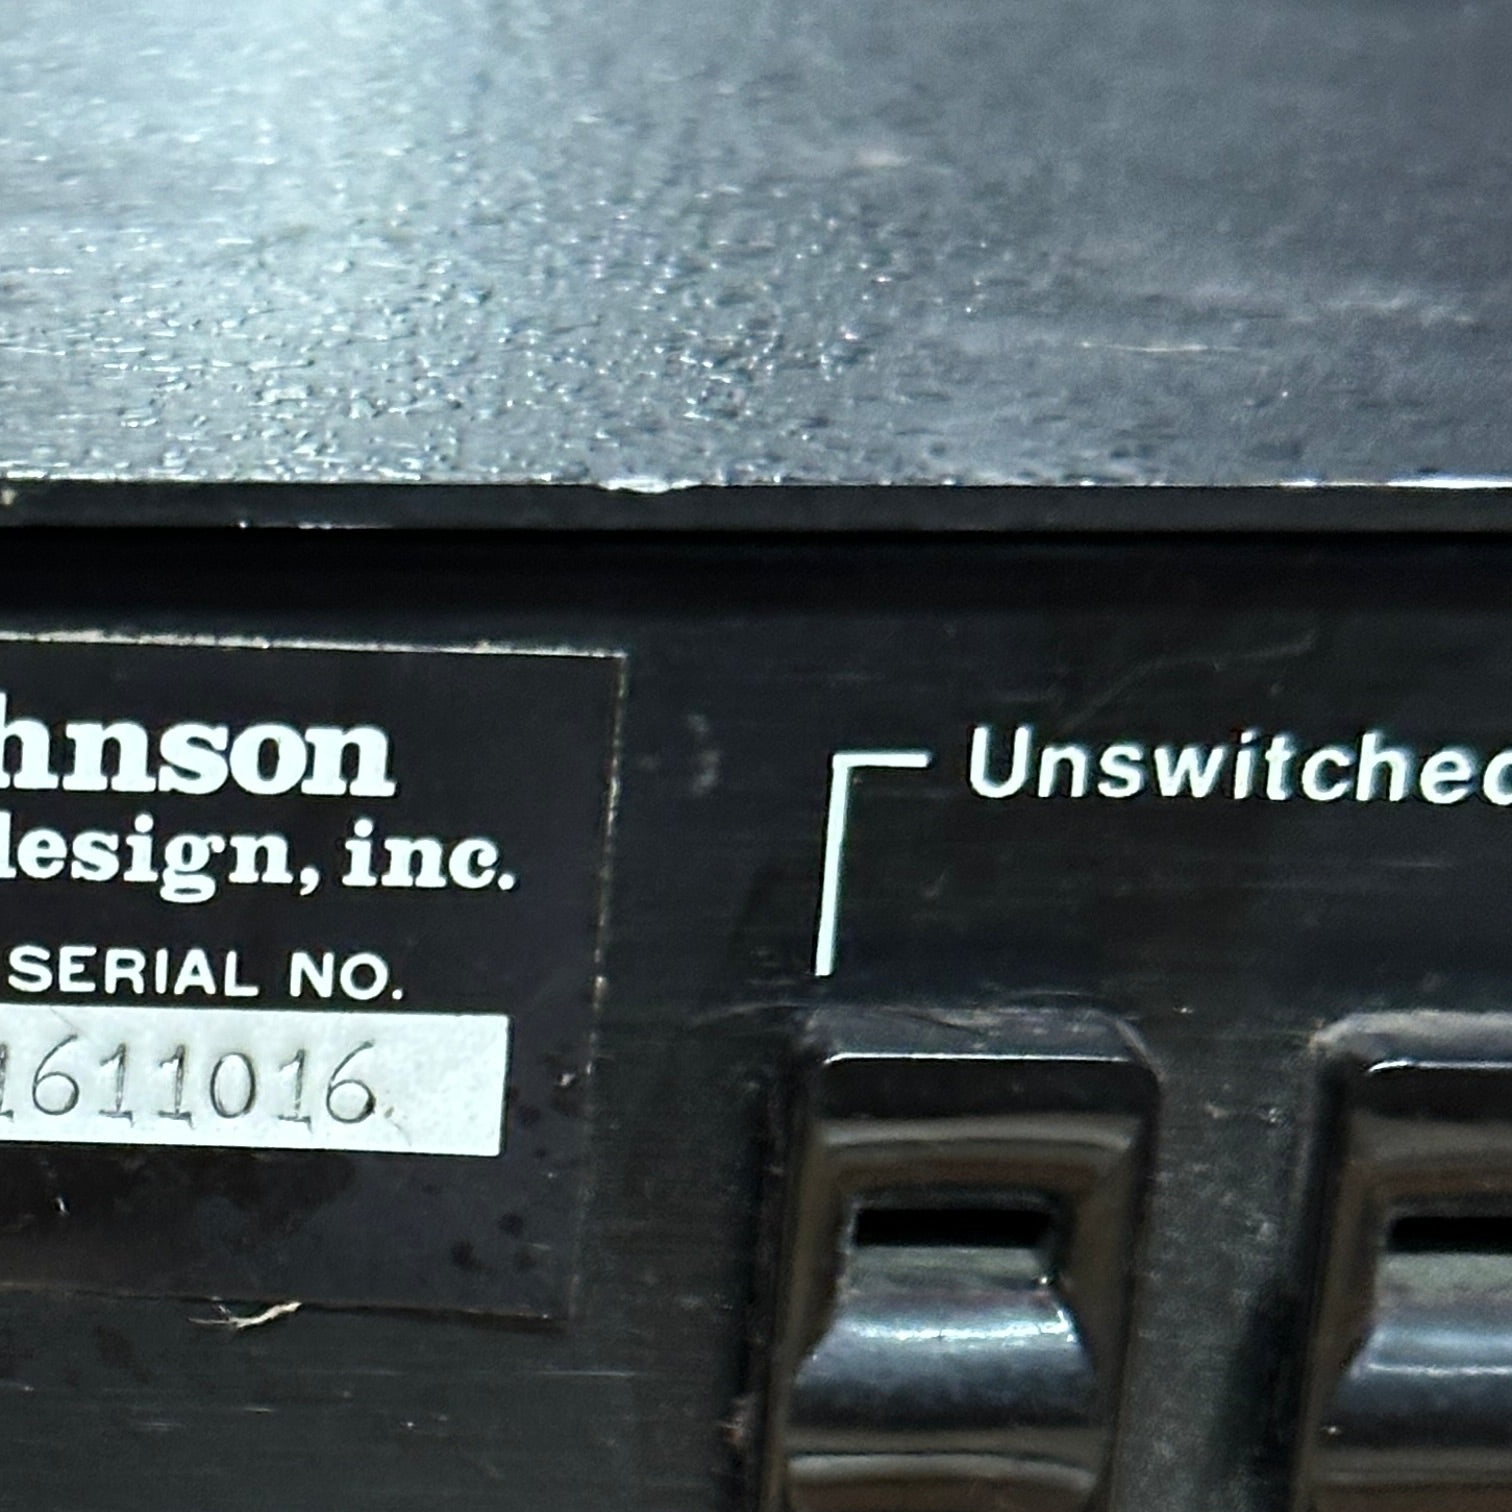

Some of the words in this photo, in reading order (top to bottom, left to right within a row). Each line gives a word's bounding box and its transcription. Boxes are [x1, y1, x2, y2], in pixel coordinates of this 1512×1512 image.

[341, 816, 516, 892] inc.
[7, 943, 260, 998] SERIAL
[288, 951, 404, 1001] NO.
